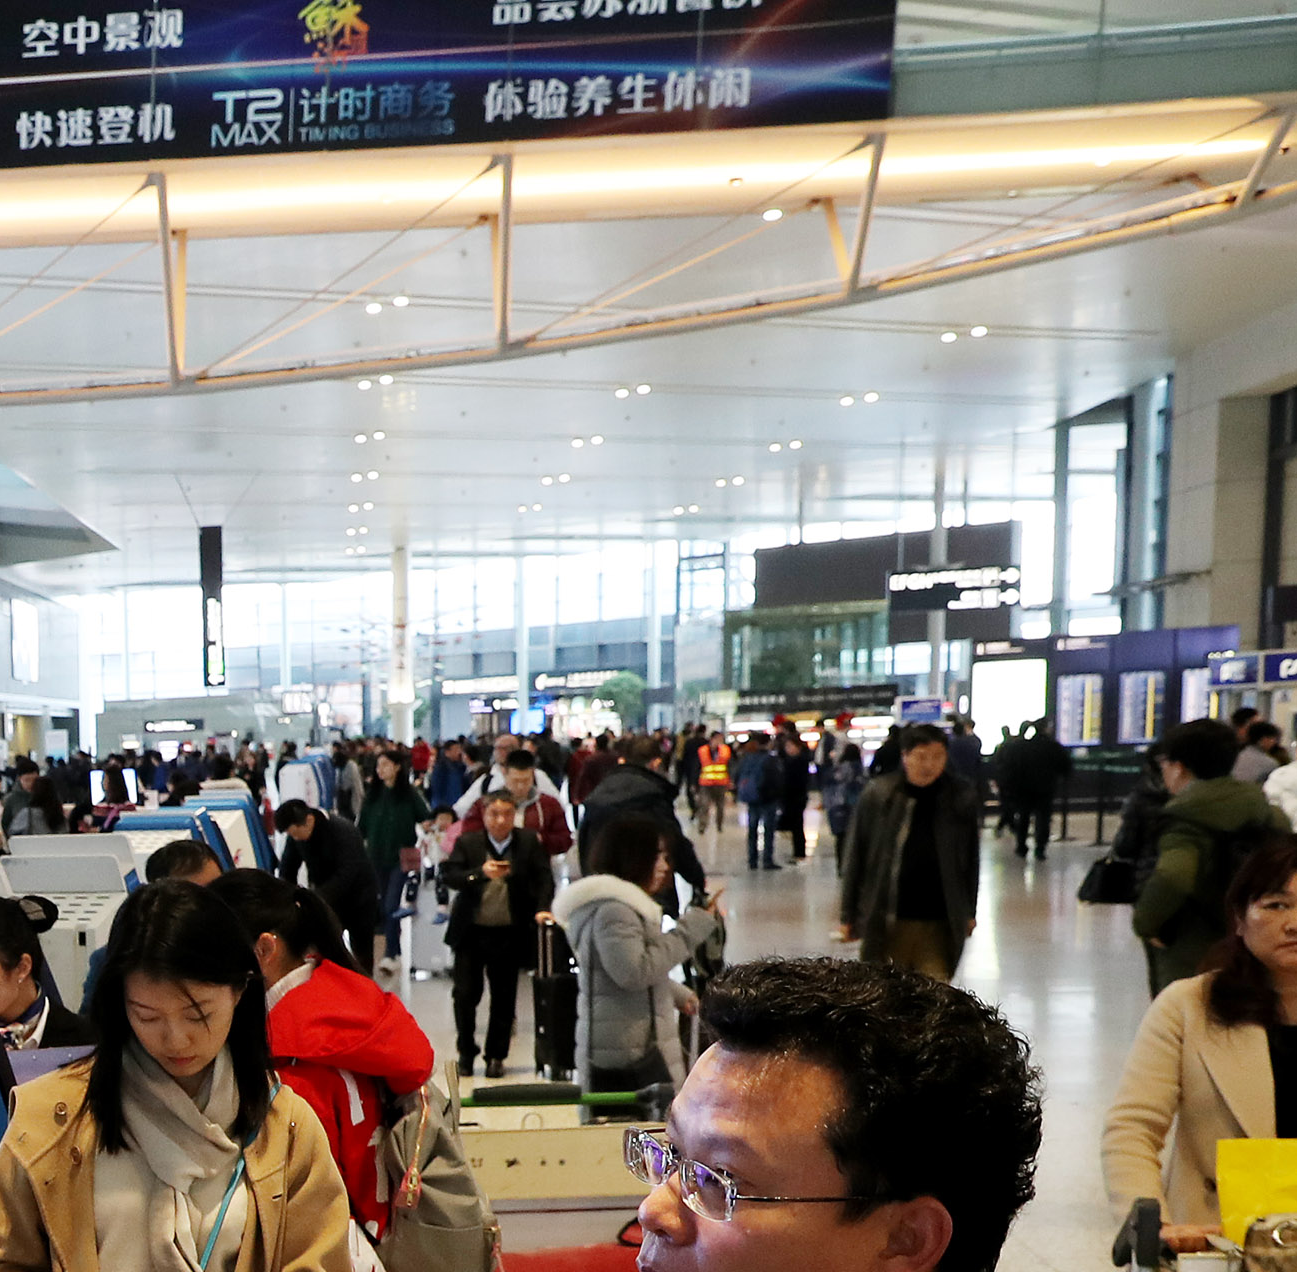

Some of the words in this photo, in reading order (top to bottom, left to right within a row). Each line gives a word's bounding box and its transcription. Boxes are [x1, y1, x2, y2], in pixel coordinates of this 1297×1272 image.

[22, 9, 183, 59] 空中景观
[483, 67, 752, 123] 体验养生休闲
[16, 102, 176, 150] 快速登机
[211, 120, 281, 148] MAX
